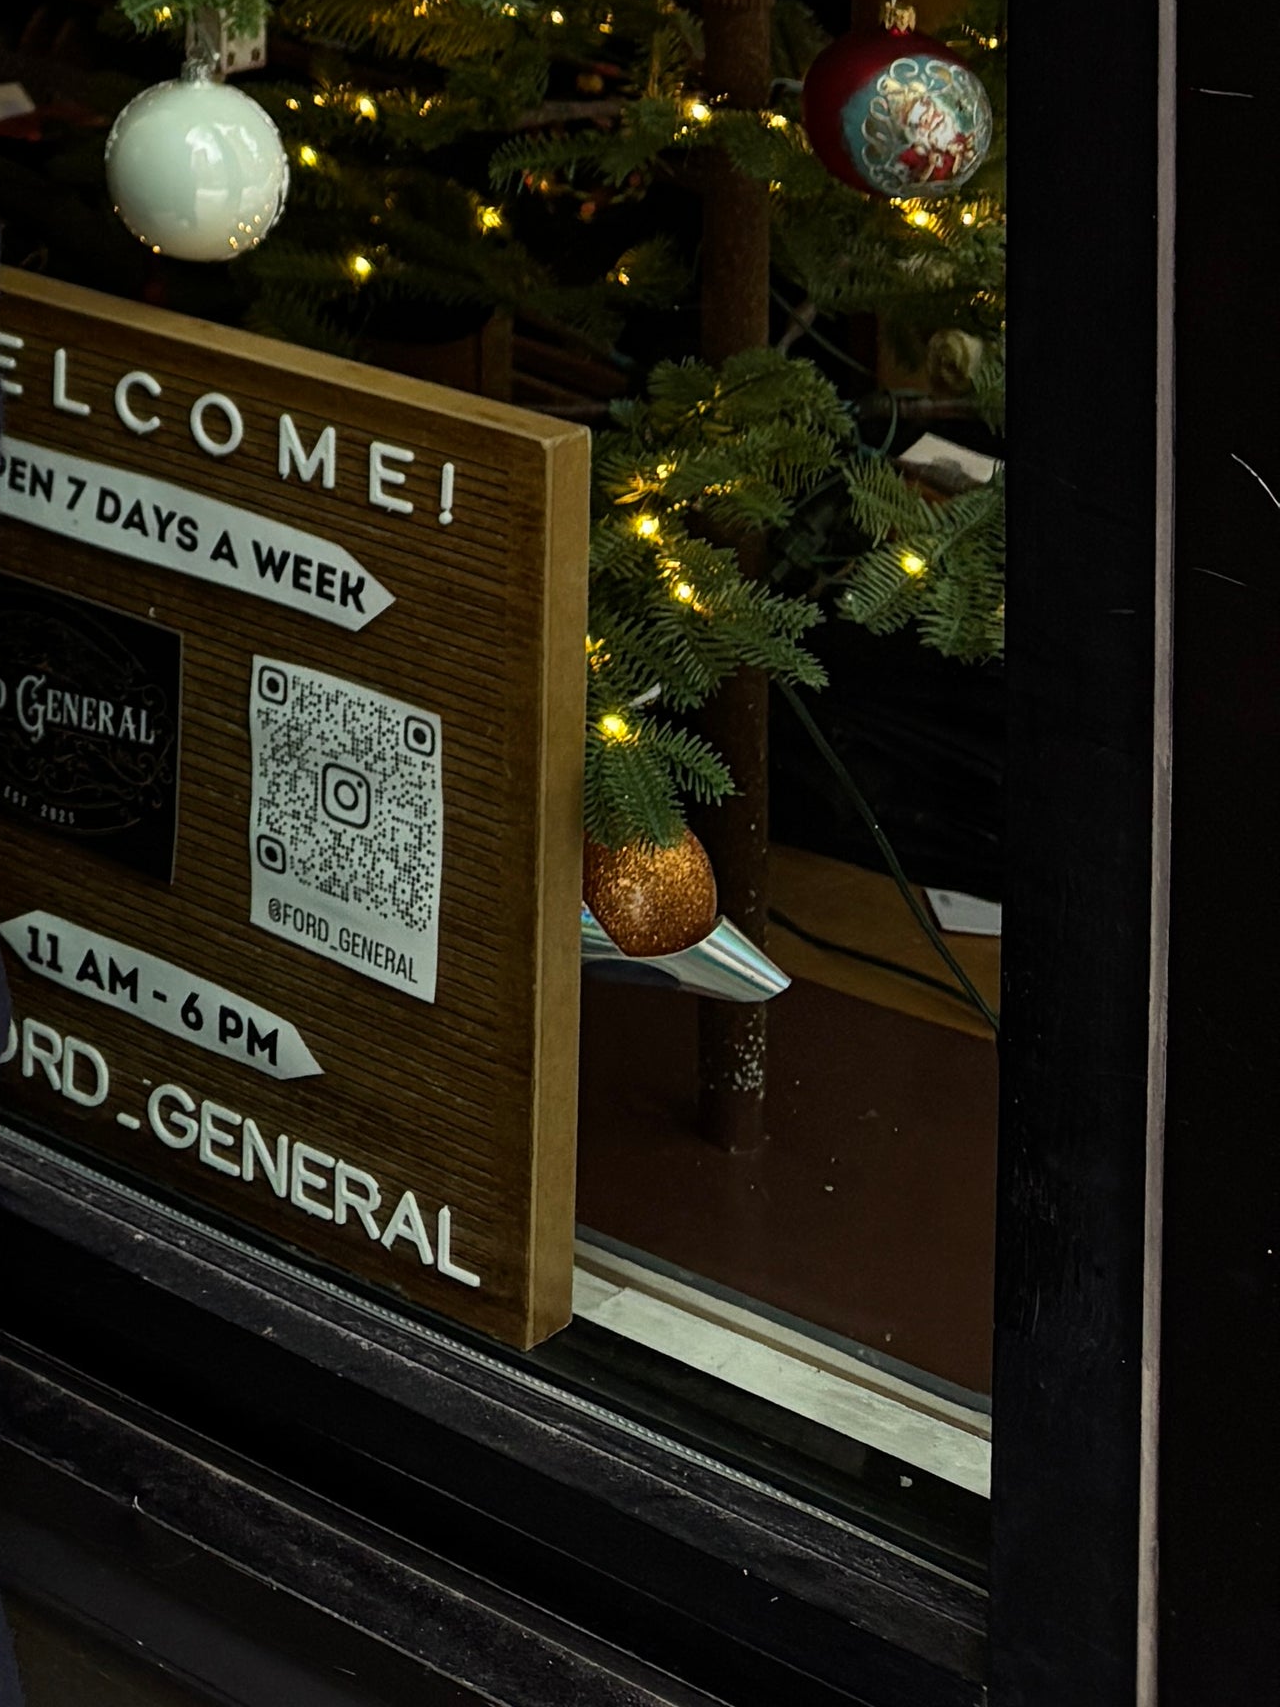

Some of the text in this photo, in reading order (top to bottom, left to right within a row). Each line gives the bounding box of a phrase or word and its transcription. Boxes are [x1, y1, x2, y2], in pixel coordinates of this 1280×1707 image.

[67, 477, 89, 511] 7
[96, 486, 199, 553] DAYS
[210, 531, 239, 569] A
[252, 540, 366, 615] WEEK
[15, 673, 156, 745] GENERAL
[26, 925, 280, 1067] 11 AM - 6 PM
[267, 897, 419, 985] @FORD_GENERAL
